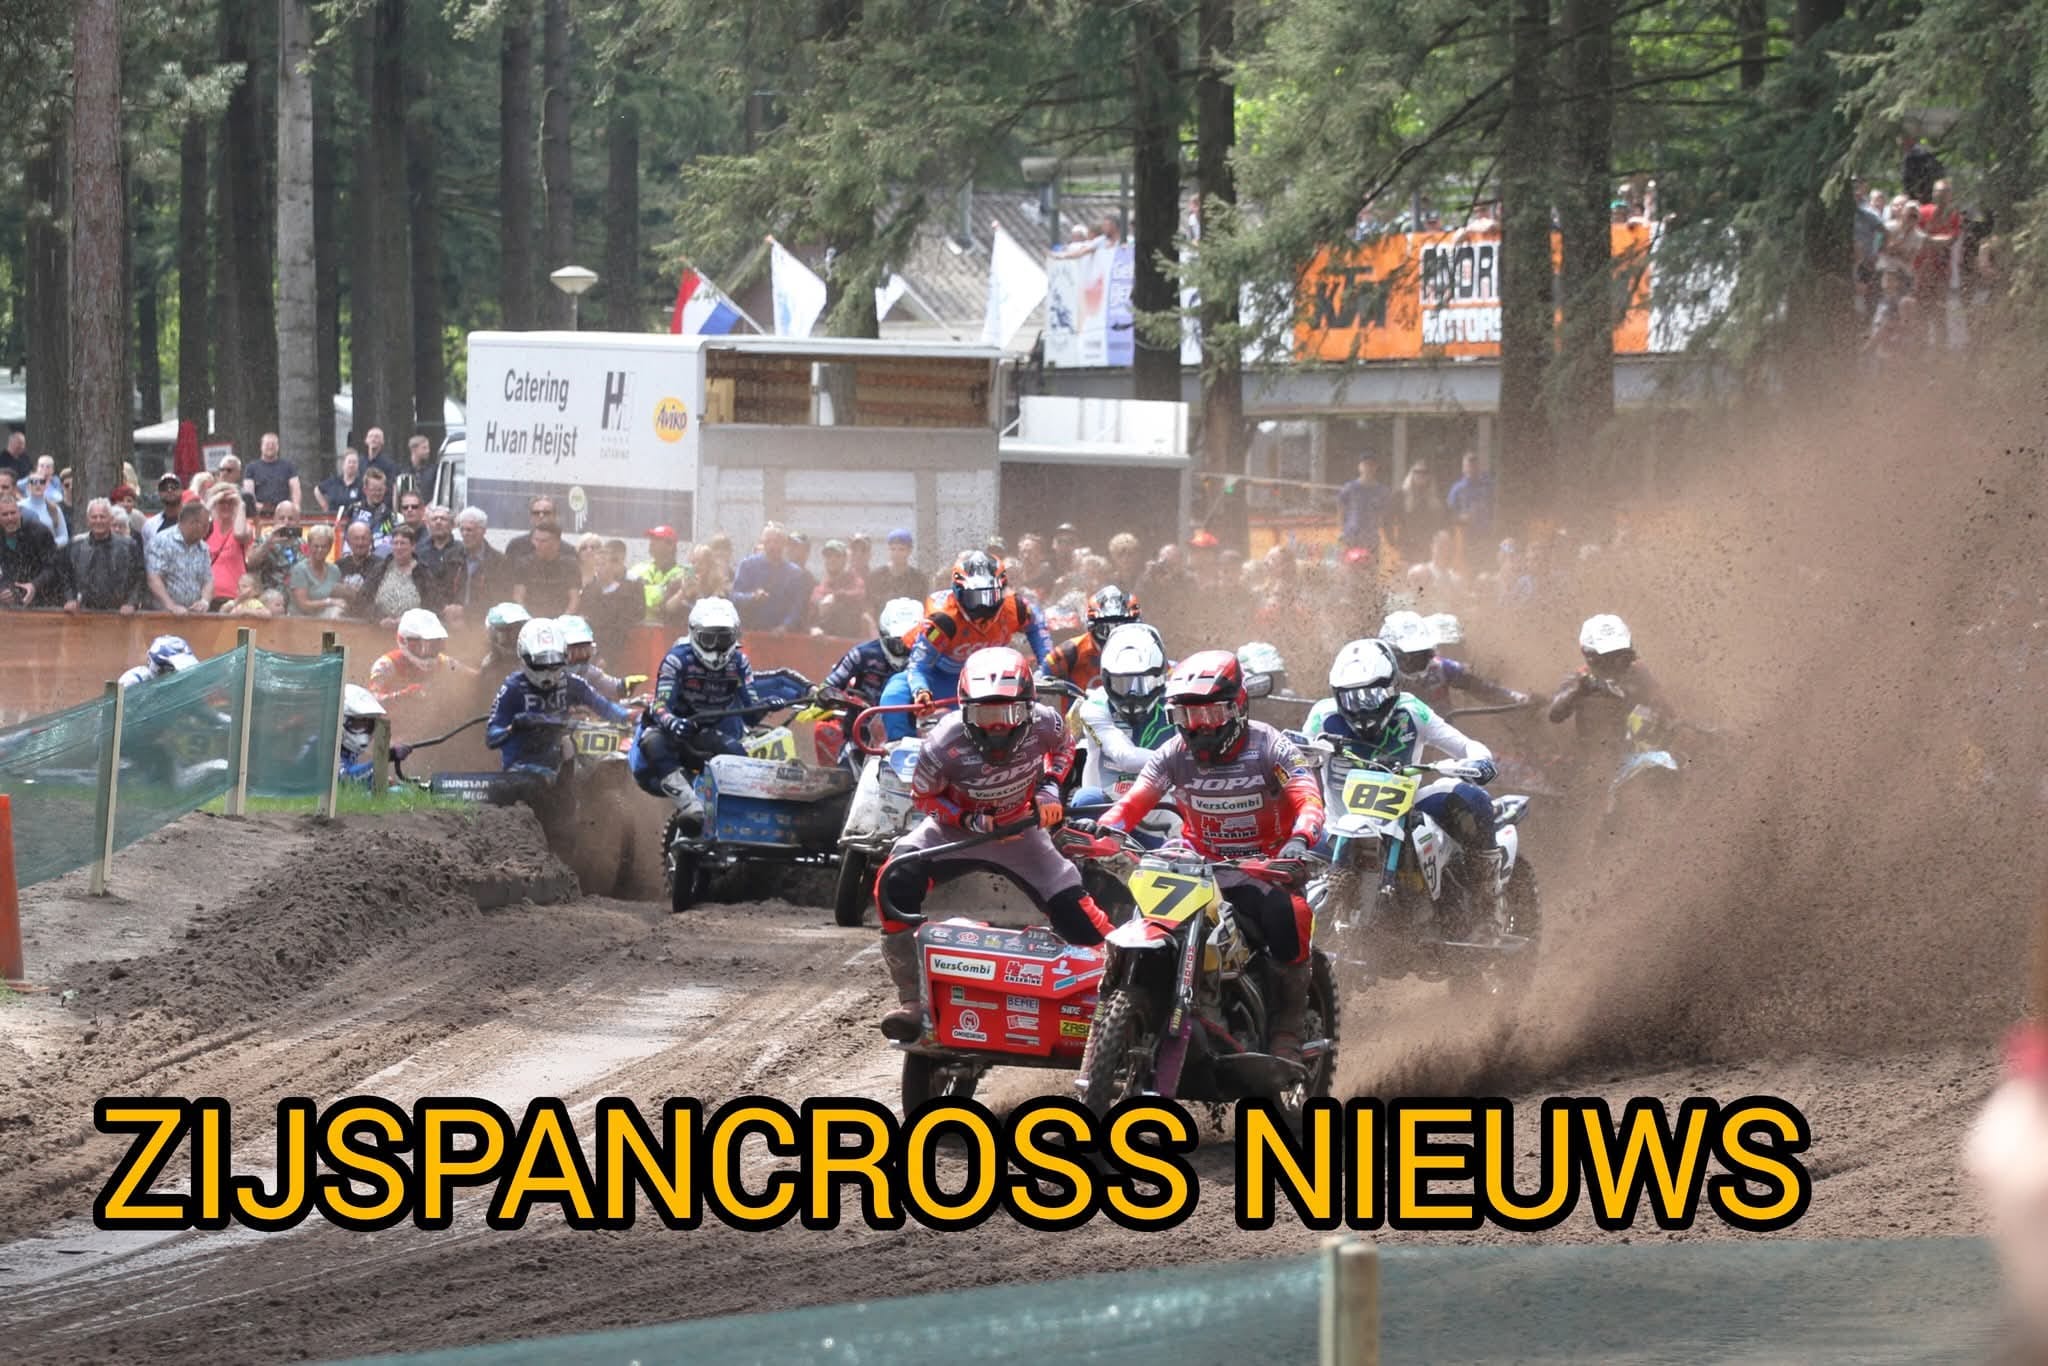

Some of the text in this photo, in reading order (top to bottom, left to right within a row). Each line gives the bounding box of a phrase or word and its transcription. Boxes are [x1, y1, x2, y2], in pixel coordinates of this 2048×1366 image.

[1422, 246, 1501, 300] ANDR
[504, 367, 569, 412] Catering
[655, 402, 688, 431] Aviko
[484, 419, 578, 465] H.van Heijst
[1184, 774, 1266, 791] JOPA
[1195, 796, 1260, 811] VersCombi
[1350, 783, 1406, 816] 82
[1150, 875, 1198, 916] 7
[934, 958, 992, 975] VersCombi
